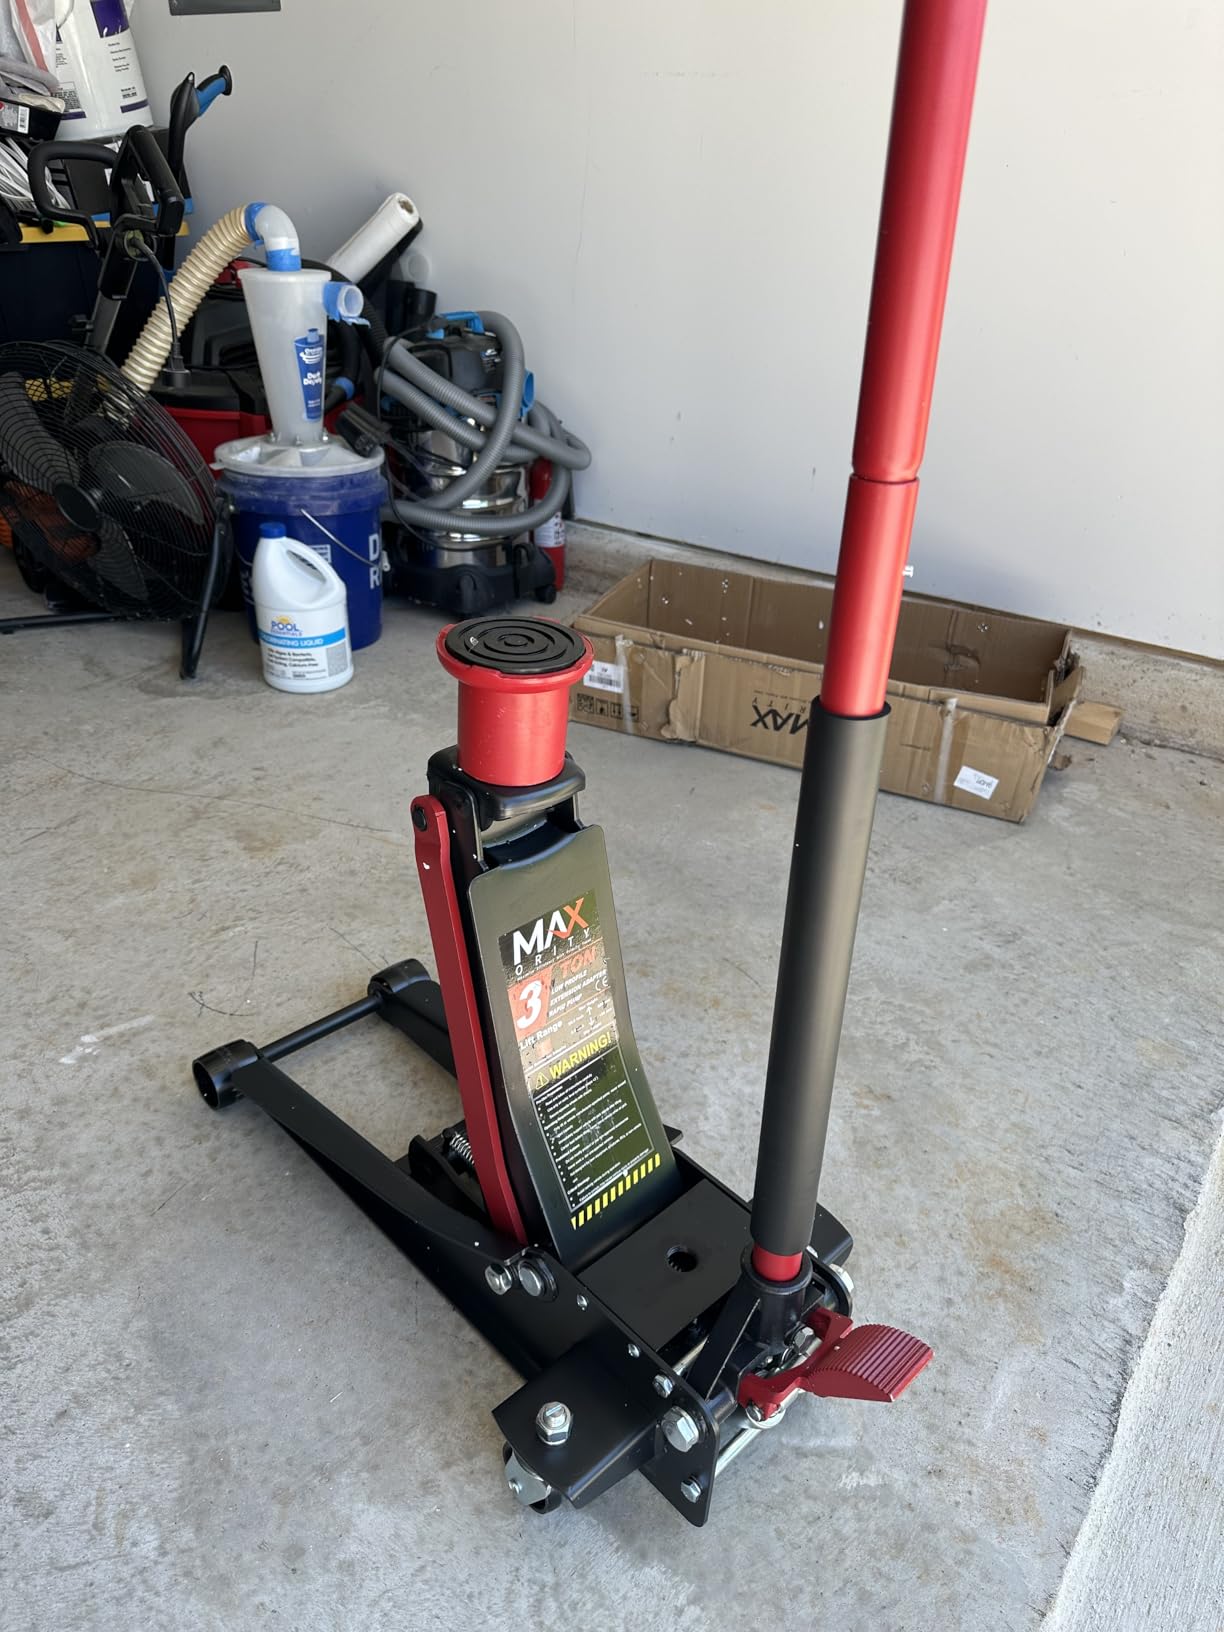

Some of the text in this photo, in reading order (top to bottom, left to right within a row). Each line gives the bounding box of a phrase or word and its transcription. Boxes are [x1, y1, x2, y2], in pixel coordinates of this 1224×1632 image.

[271, 621, 300, 632] POOL
[513, 897, 589, 967] MAX
[516, 979, 543, 1030] 3
[559, 944, 597, 979] TON
[550, 969, 607, 1007] EXTENSION ADAPTER
[551, 969, 588, 995] LOW PROFILE
[566, 993, 583, 1008] PUMP
[519, 1036, 536, 1051] Lift
[536, 1020, 563, 1042] Range
[549, 1031, 612, 1080] WARNING!
